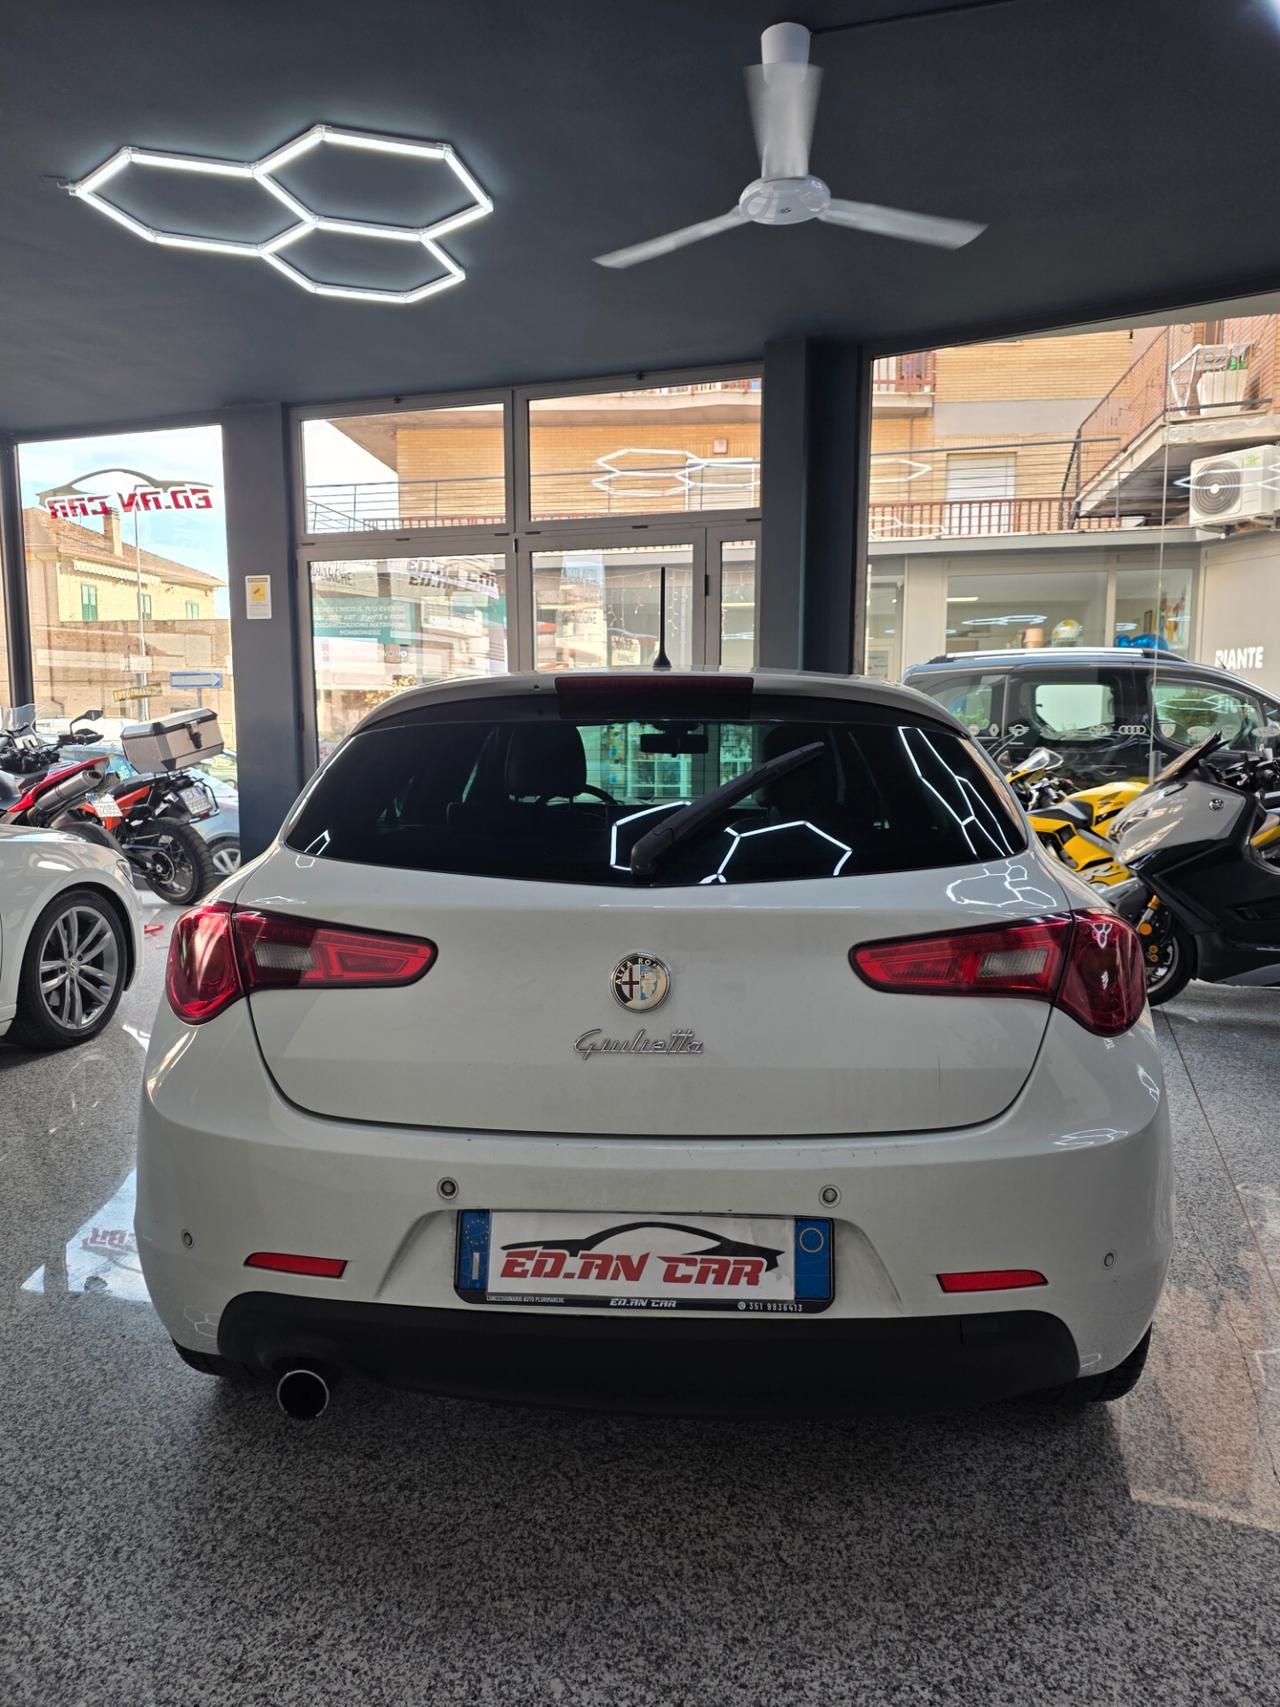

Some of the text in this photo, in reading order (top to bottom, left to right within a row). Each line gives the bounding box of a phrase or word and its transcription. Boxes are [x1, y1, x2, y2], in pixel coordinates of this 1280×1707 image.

[1215, 646, 1264, 670] PIANTE
[573, 1028, 704, 1061] Giulietta
[500, 1250, 767, 1286] ED.AN CAR
[609, 1298, 677, 1308] ED.AN CAR
